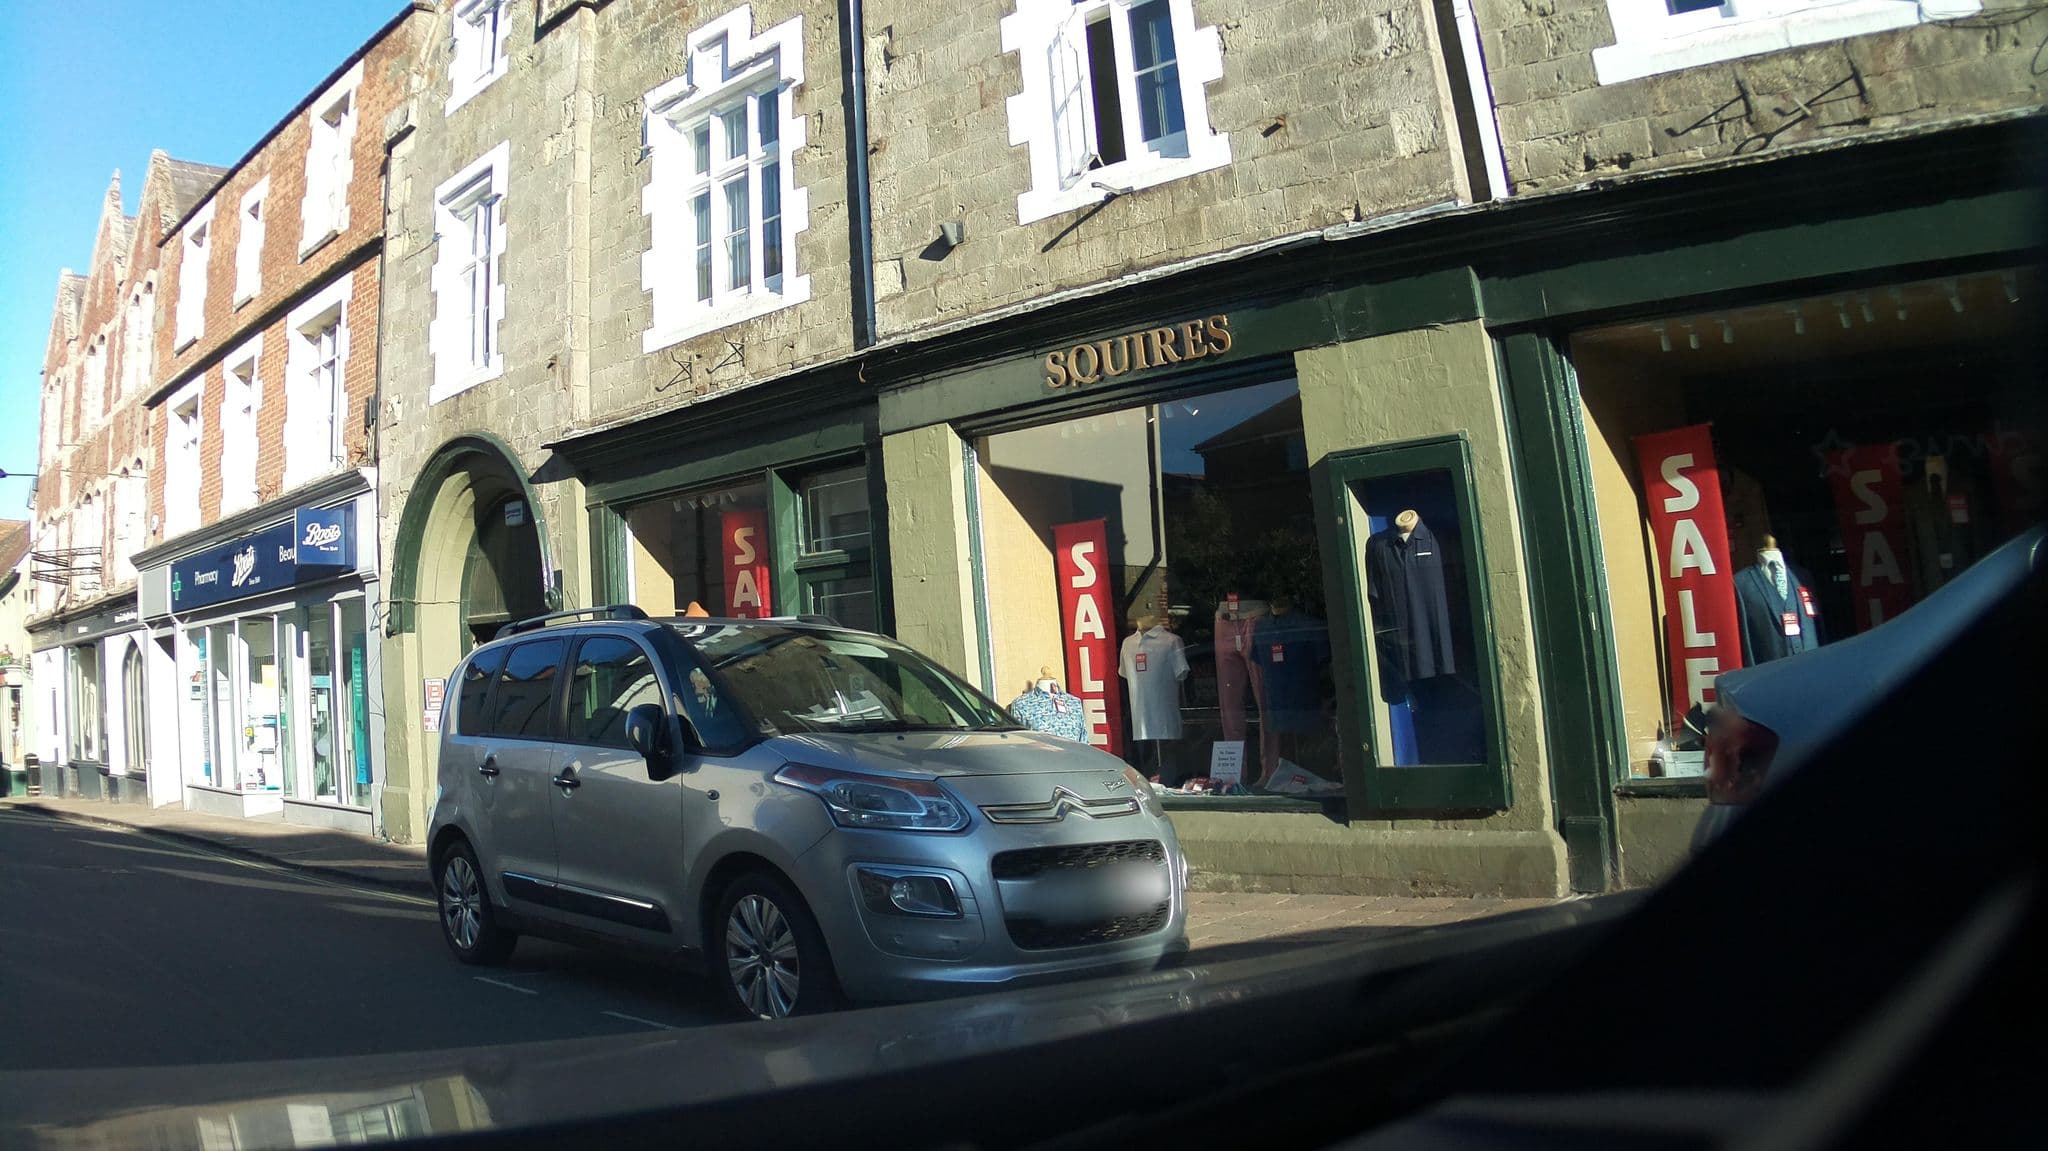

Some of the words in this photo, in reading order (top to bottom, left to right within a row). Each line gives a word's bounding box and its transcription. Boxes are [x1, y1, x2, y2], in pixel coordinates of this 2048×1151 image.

[1045, 314, 1233, 388] SQUIRES
[232, 545, 255, 587] Boots
[302, 522, 341, 547] Boots
[194, 569, 219, 586] Pharmacy
[733, 528, 761, 617] SA
[1660, 453, 1717, 712] SALE
[1071, 541, 1108, 745] SALE
